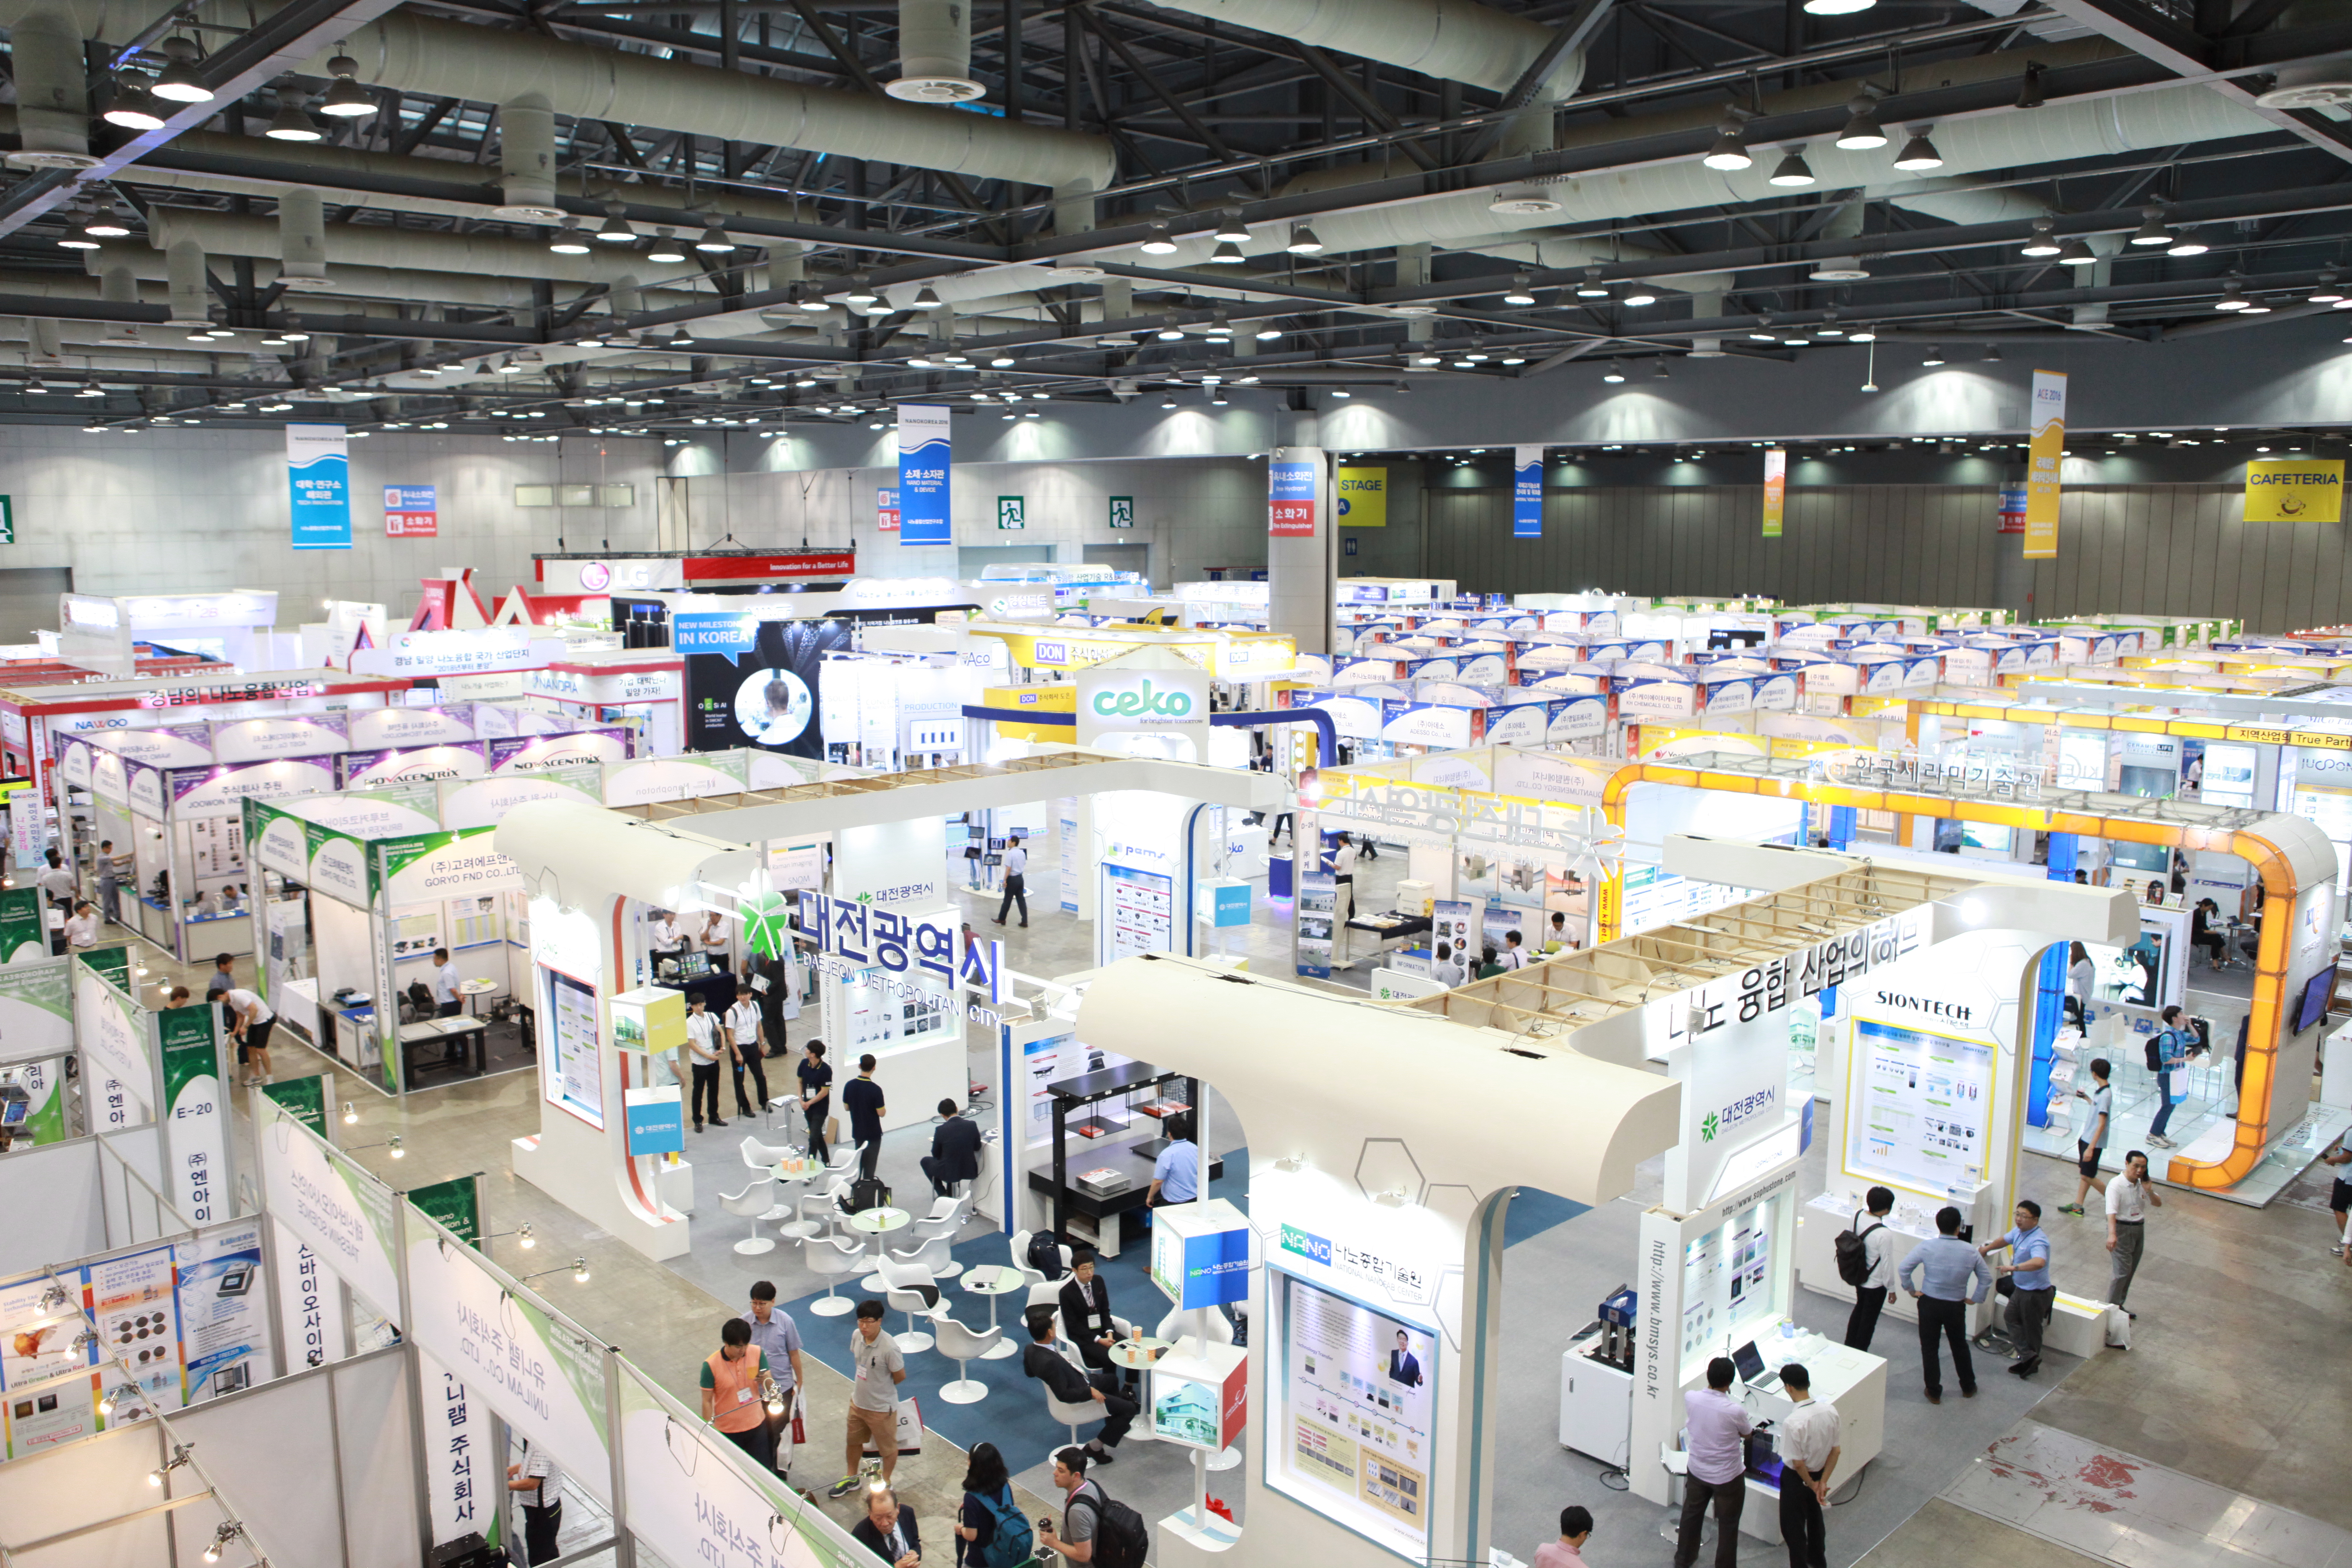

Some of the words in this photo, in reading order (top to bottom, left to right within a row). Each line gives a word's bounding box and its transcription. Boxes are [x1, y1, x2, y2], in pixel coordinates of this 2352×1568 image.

[2037, 389, 2047, 400] ACE
[2049, 388, 2061, 401] 2016
[1273, 472, 1313, 482] 옥내소화전
[2251, 474, 2339, 485] CAFETERIA
[1341, 480, 1382, 491] STAGE
[1276, 508, 1307, 519] 소화기
[614, 565, 649, 587] LG
[679, 633, 696, 645] IN
[698, 631, 749, 645] KOREA
[395, 656, 412, 666] 경남
[438, 652, 472, 663] 나노융합
[476, 652, 493, 661] 국가
[497, 649, 529, 659] 산업단지
[1039, 645, 1063, 660] DON
[1231, 652, 1248, 662] DON
[1350, 672, 1386, 681] (주)나노미래생활
[149, 688, 201, 706] 경남의
[625, 688, 640, 697] 밀양
[644, 687, 661, 696] 가자!
[1093, 679, 1191, 717] ceko
[904, 702, 957, 711] PRODUCTION
[75, 719, 128, 730] NAWOO
[1417, 720, 1445, 730] (주)아데소
[1505, 721, 1526, 731] (주)아데소
[2240, 729, 2292, 743] 지역산업의
[2296, 734, 2321, 745] True
[514, 754, 601, 770] NOVACENTRIX
[1855, 754, 2041, 799] 한국세라믹기술원
[222, 784, 259, 794] 주식회사
[263, 780, 282, 792] 주원
[188, 798, 225, 809] JOOWON
[1126, 846, 1165, 859] pems
[791, 859, 812, 869] Imaging
[425, 874, 460, 888] GORYO
[463, 872, 482, 881] FND
[788, 875, 810, 885] SNOM
[876, 882, 934, 903] 대전광역시
[799, 889, 1003, 1005] 대전광역시
[1397, 960, 1425, 972] INFORMATION
[1737, 956, 1791, 1023] 융합
[1800, 928, 1869, 998] 산업의
[1870, 915, 1920, 963] 허브
[802, 951, 856, 983] DAEJEON
[862, 971, 961, 1018] METROPOLITAN
[969, 1005, 1003, 1030] CITY
[1875, 990, 1972, 1021] SIONTECH
[1963, 1046, 1988, 1054] SIONTECH
[177, 1102, 212, 1119] E-20
[1722, 1085, 1775, 1124] 대전광역시
[645, 1123, 677, 1132] 대전광역시
[1720, 1121, 1738, 1135] DAEJEON
[1738, 1112, 1765, 1128] METROPOLITAN
[1766, 1105, 1774, 1115] CITY
[1722, 1170, 1796, 1217] http://www.sophustone.com
[463, 1216, 470, 1225] &
[1282, 1229, 1331, 1260] NANO
[1190, 1268, 1212, 1277] NANO
[1335, 1243, 1422, 1289] 나노종합기술원
[1334, 1261, 1364, 1281] NATIONAL
[1365, 1271, 1395, 1292] NANOFAB
[1397, 1286, 1423, 1302] CENTER
[1647, 1239, 1666, 1400] http://www.bmsys.co.kr
[1296, 1341, 1318, 1355] Technology
[1318, 1351, 1333, 1361] Transfer
[11, 1379, 27, 1389] Ultra
[28, 1374, 48, 1384] Green
[56, 1367, 72, 1377] Ultra
[73, 1363, 85, 1372] Red
[450, 1434, 475, 1523] 주식회사
[1393, 1527, 1425, 1545] www.nnfc.re.kr
